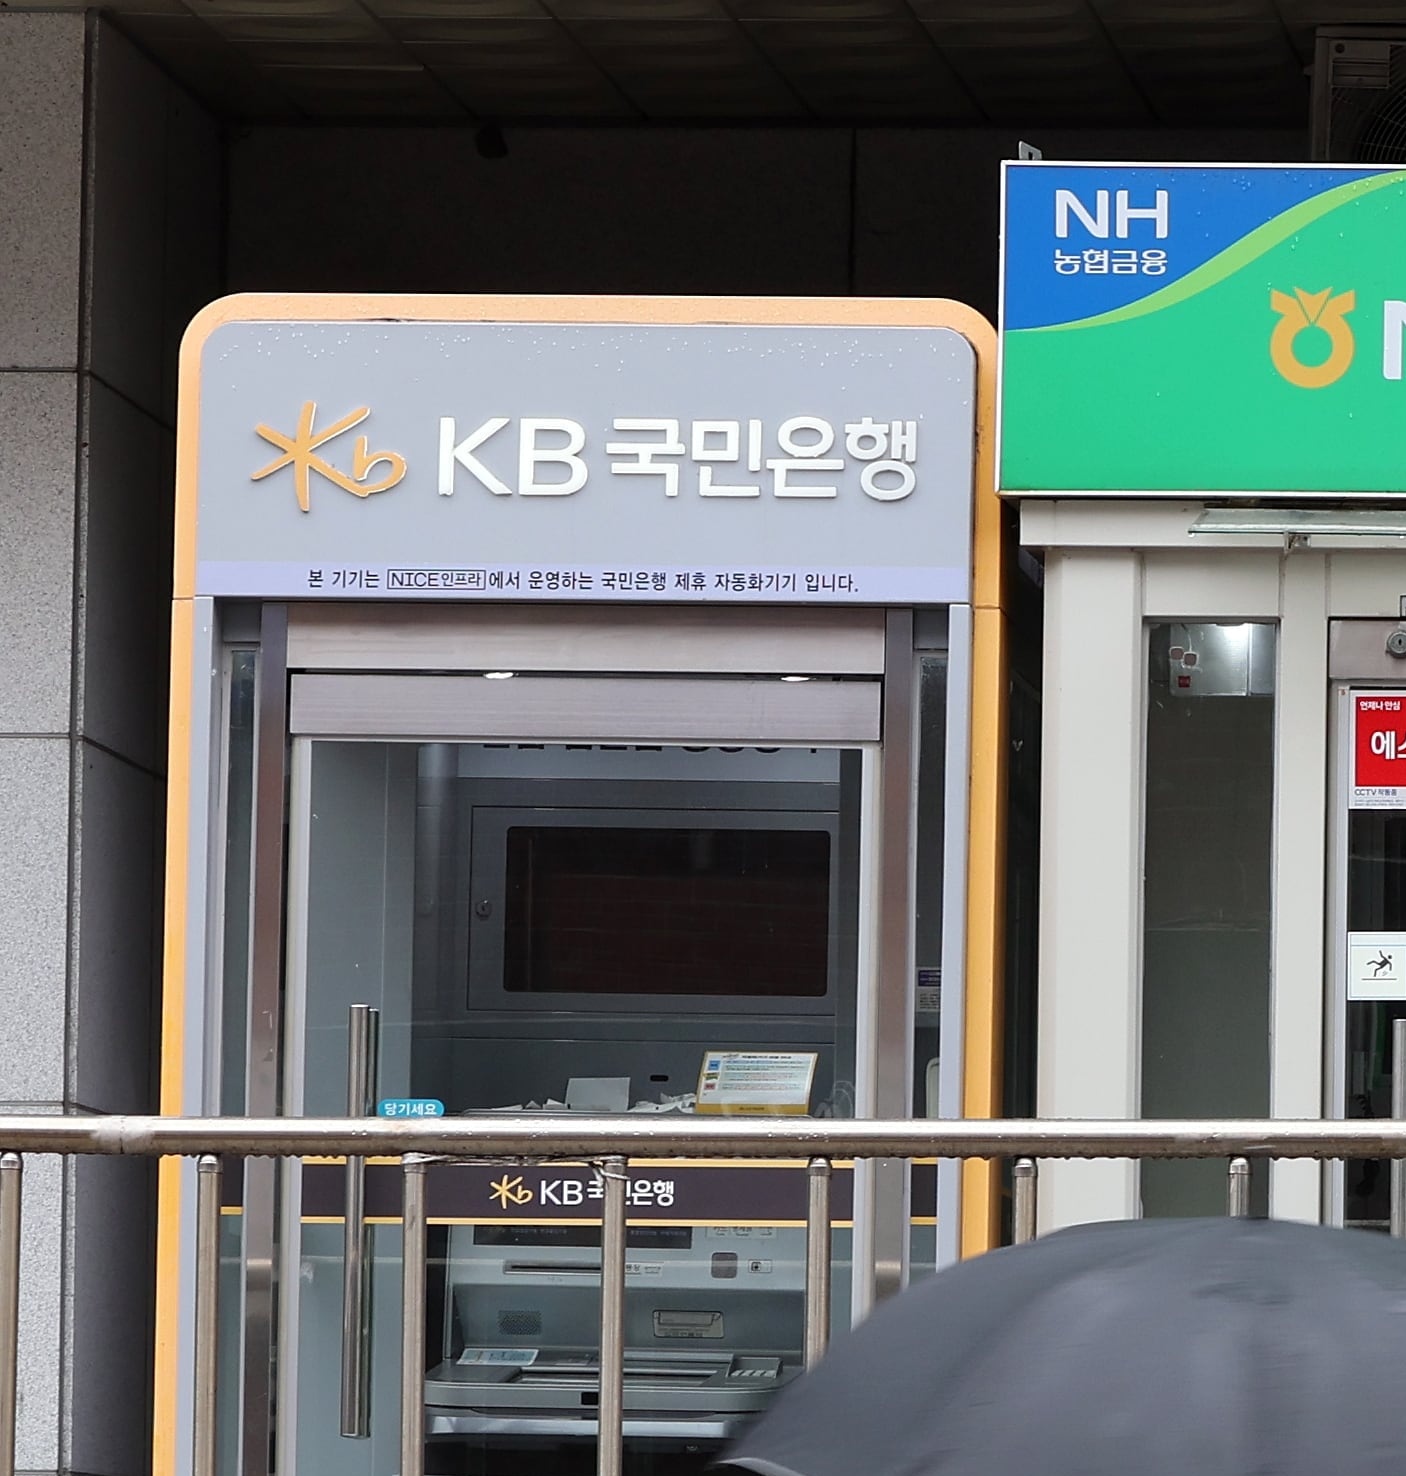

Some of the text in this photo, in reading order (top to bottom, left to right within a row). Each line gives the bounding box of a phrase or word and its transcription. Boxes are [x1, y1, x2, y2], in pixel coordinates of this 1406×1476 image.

[1054, 189, 1168, 238] NH
[1052, 248, 1168, 277] 농협금융
[308, 570, 858, 592] 본 기기는 NICE인프라 에서 운영하는 국민은행 제휴 자동화기기 입니다.
[384, 1103, 437, 1116] 당기세요
